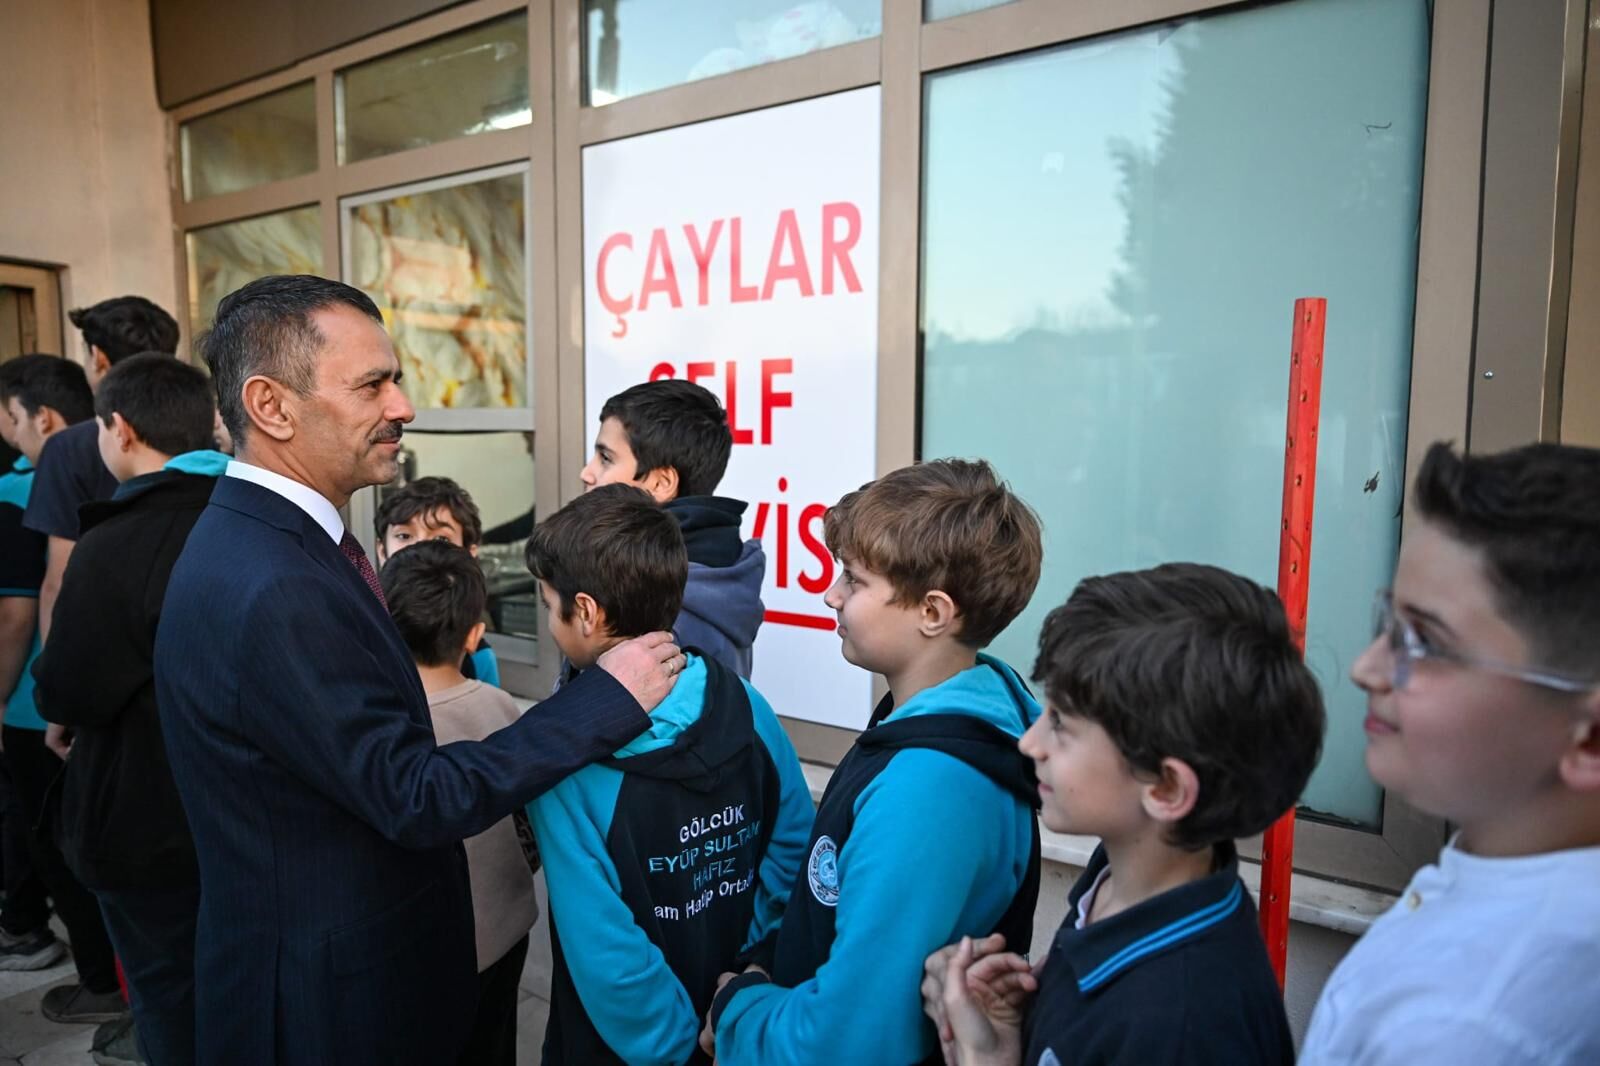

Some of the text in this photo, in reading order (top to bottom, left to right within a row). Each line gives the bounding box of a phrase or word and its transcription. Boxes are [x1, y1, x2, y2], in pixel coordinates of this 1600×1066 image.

[597, 201, 863, 338] ÇAYLAR
[648, 358, 793, 446] LF
[679, 804, 745, 843] GÖLCÜK
[649, 848, 699, 873] EYÜP
